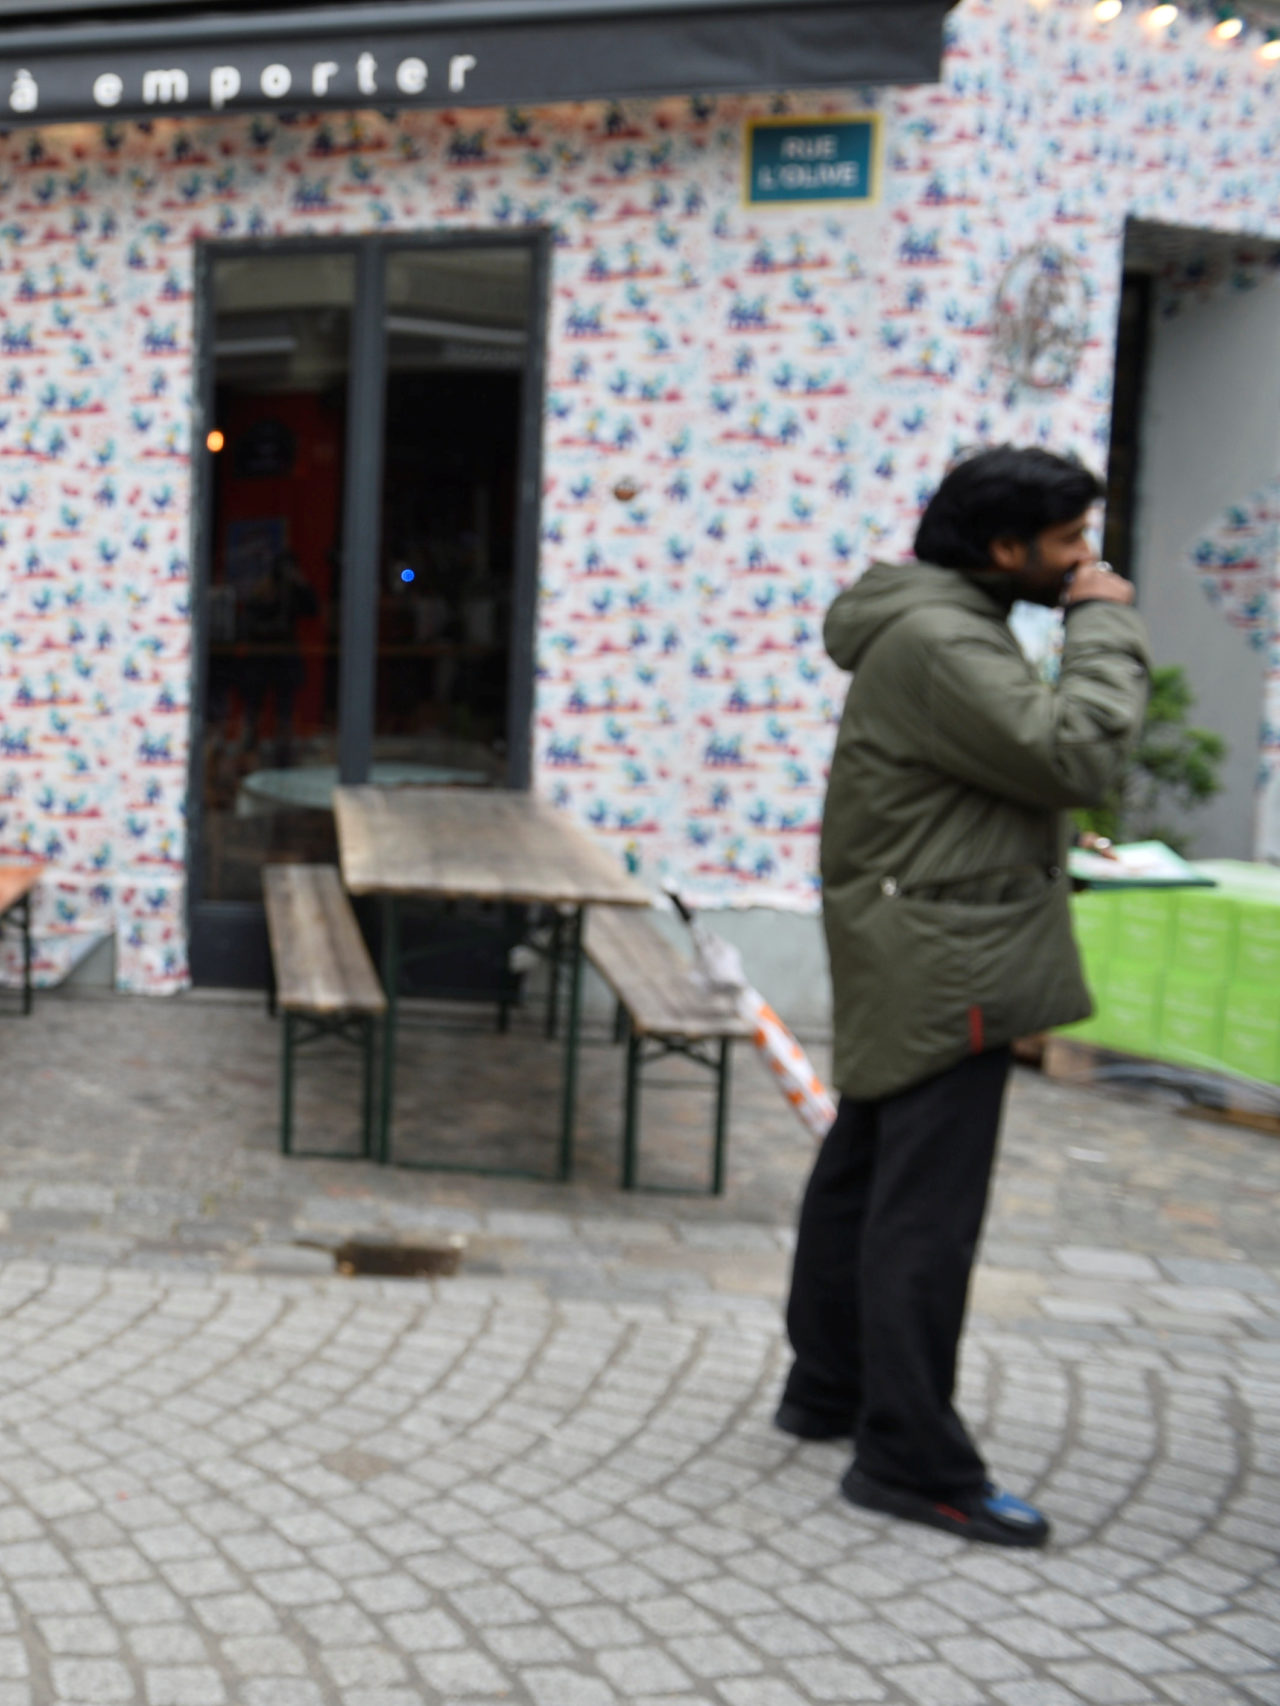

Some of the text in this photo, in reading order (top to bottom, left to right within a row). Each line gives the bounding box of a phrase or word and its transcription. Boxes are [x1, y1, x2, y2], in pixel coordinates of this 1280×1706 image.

[10, 68, 39, 114] à
[93, 51, 477, 110] emporter
[780, 135, 838, 160] RUE
